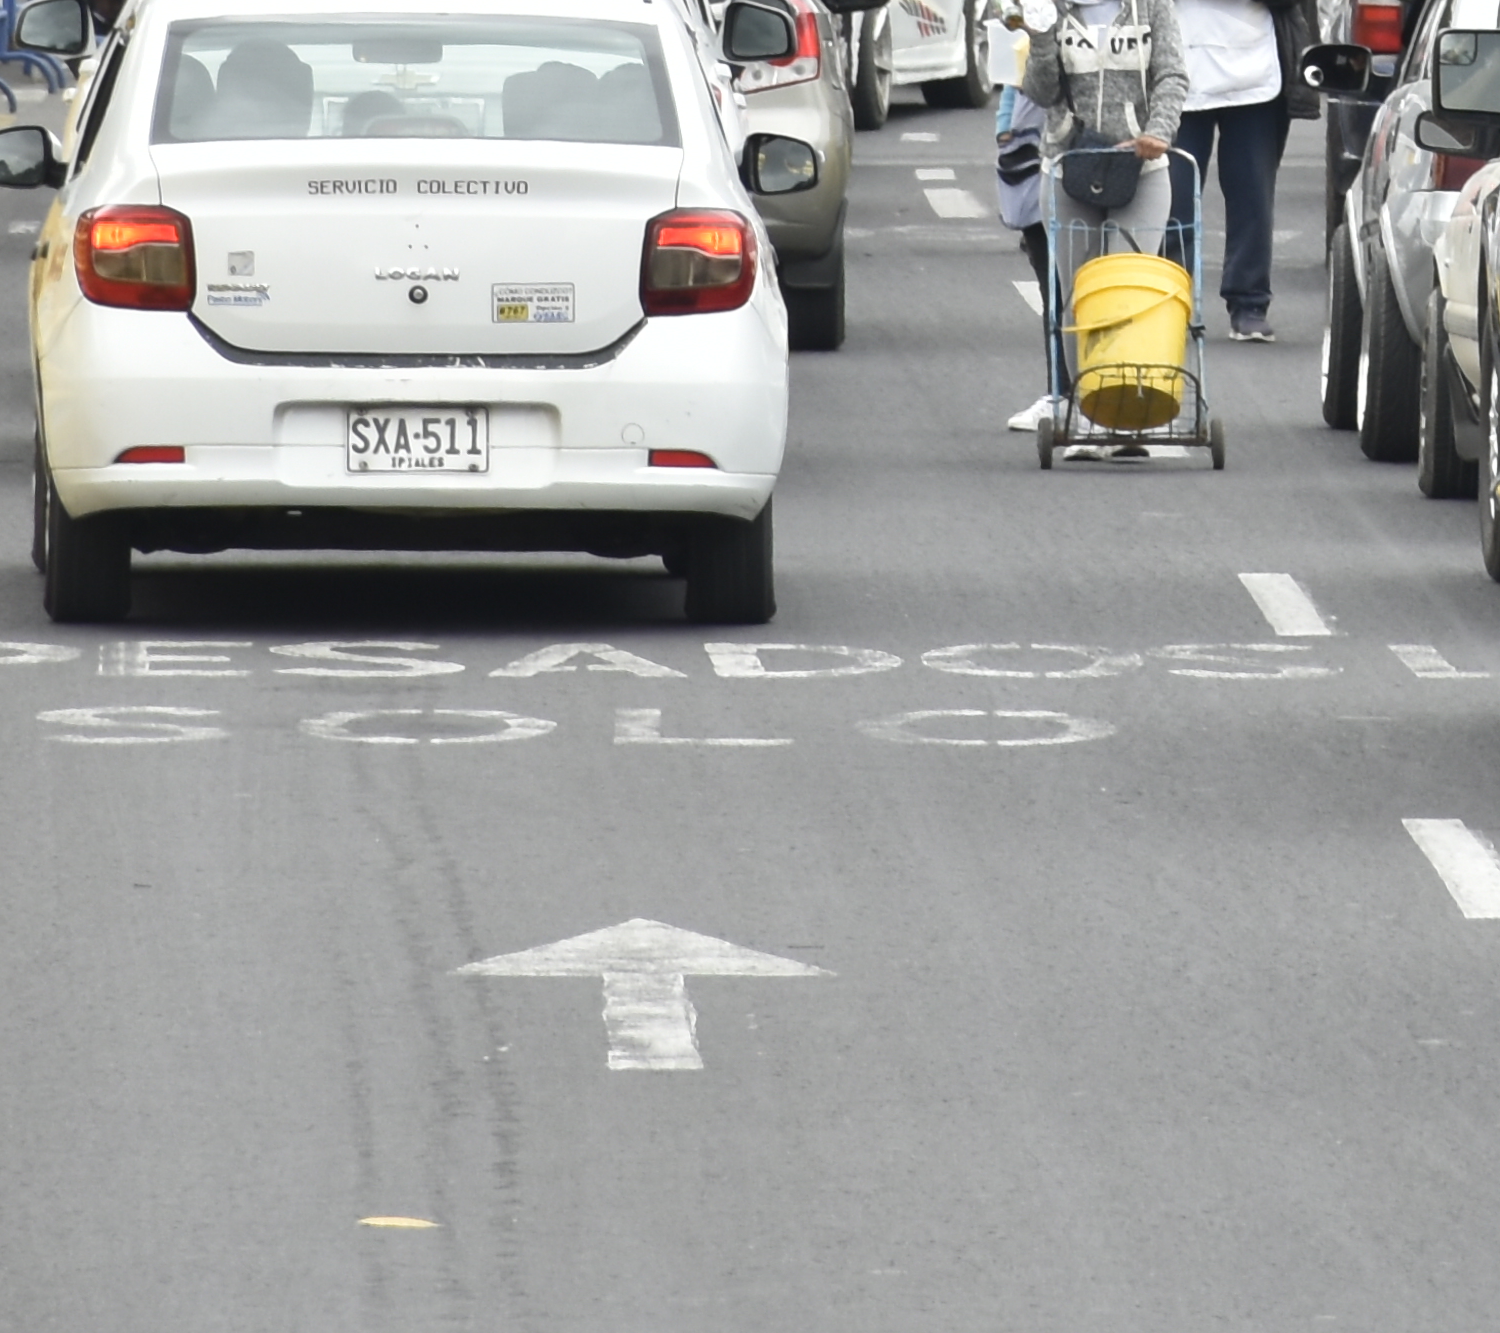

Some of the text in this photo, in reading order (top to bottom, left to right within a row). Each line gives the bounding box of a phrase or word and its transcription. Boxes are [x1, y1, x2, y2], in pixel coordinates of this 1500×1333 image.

[307, 178, 530, 195] SERVICIO COLECTIVO
[373, 266, 461, 282] LOGAN
[390, 456, 445, 469] IPIALES
[36, 704, 1116, 748] SOLO
